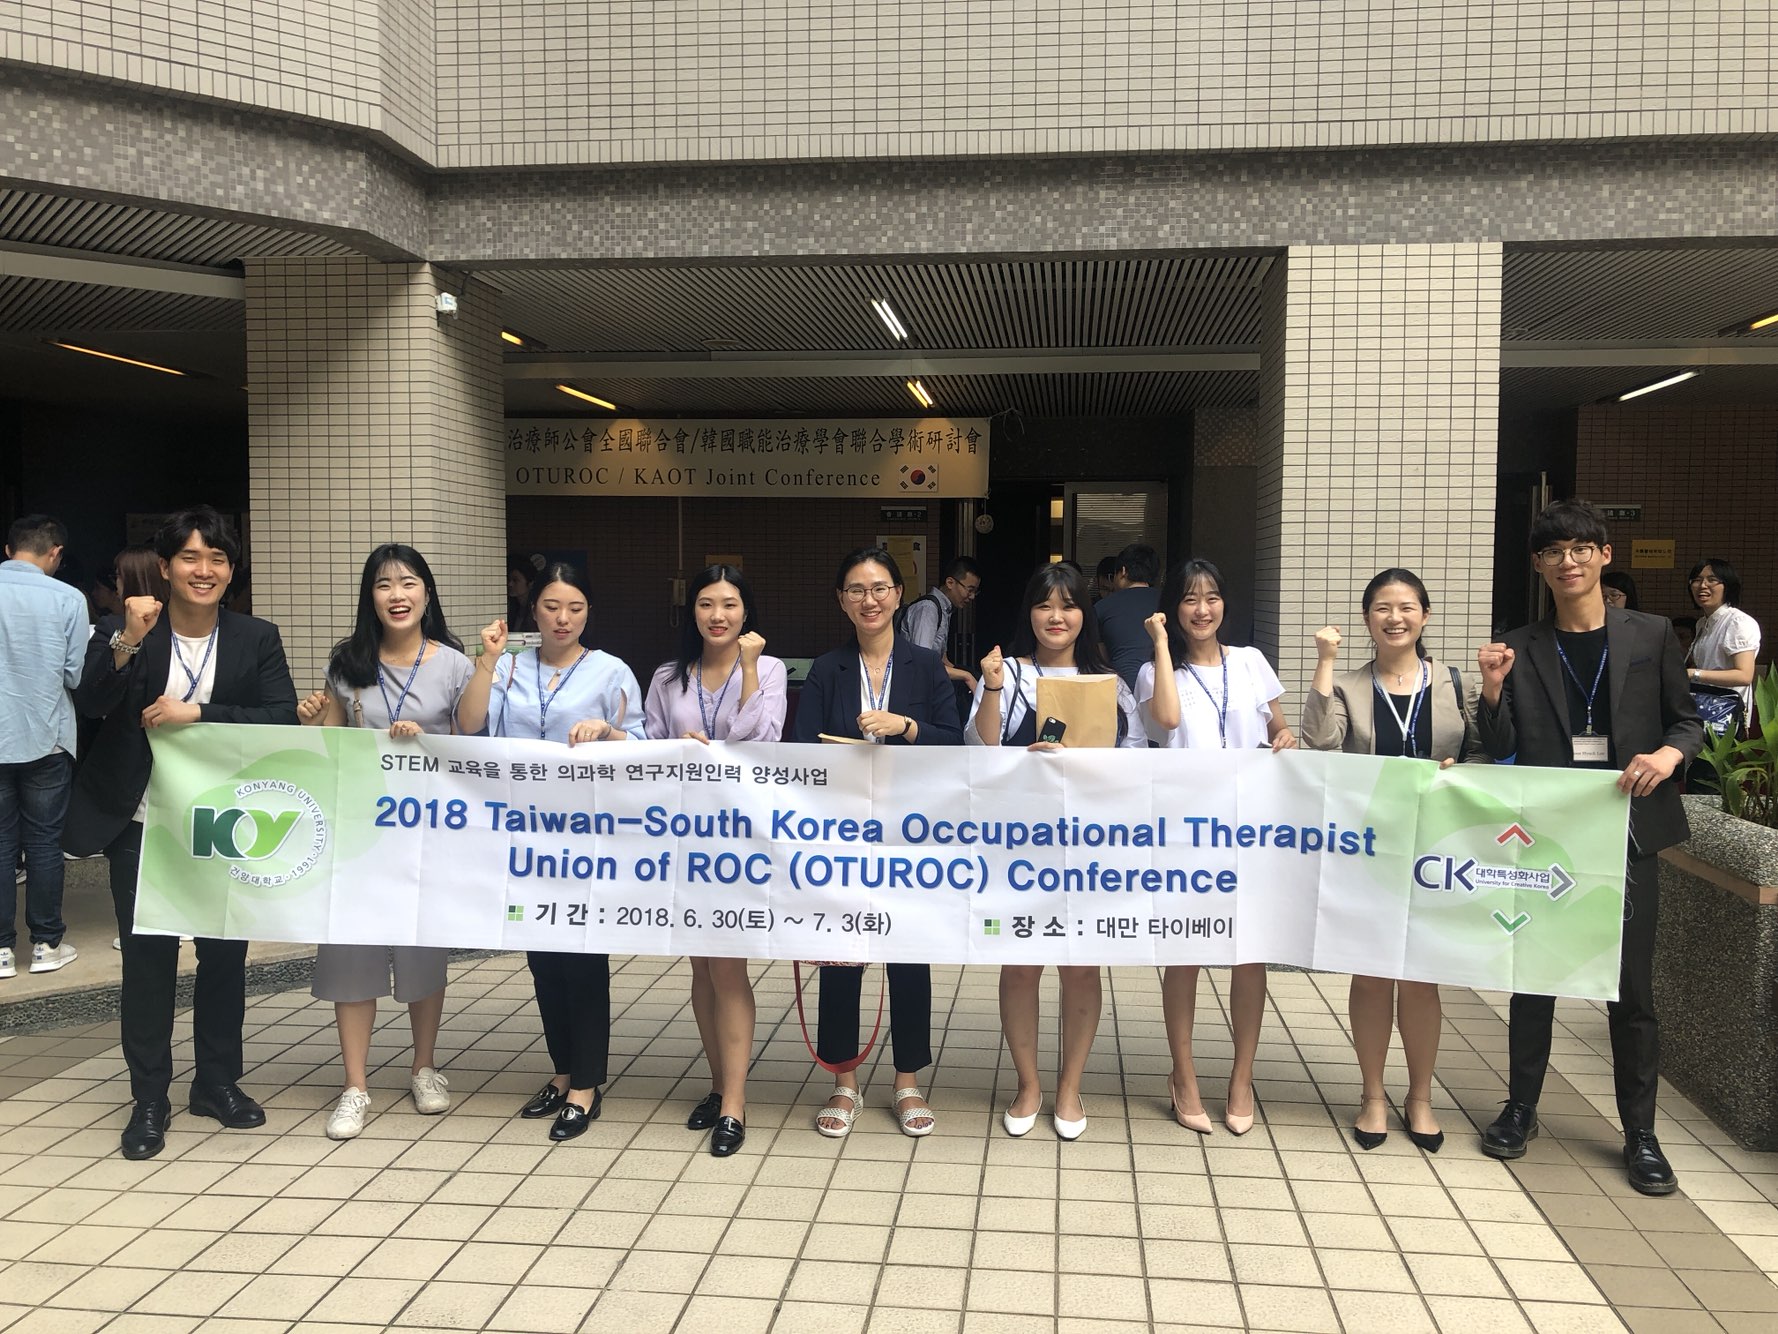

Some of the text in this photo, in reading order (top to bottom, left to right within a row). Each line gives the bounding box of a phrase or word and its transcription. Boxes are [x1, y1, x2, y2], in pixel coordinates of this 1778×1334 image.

[515, 466, 609, 485] OTUROC
[634, 466, 697, 485] KAOT
[705, 467, 756, 486] Joint
[764, 467, 881, 487] Conference
[380, 753, 828, 787] STEM 교육을 통한 의과학 연구지원인력 양성사업
[235, 780, 295, 797] KONYANG
[297, 790, 325, 852] UNIVERSITY
[374, 796, 469, 831] 2018
[771, 809, 884, 845] Korea
[901, 812, 1167, 851] Occupational
[1183, 816, 1378, 858] Therapist
[230, 866, 284, 886] 건양대학교
[291, 856, 316, 877] 1991
[508, 846, 1239, 894] Union of ROC (OTUROC) Conference
[1413, 855, 1476, 892] CK
[1475, 868, 1550, 884] 대학특성화사업
[616, 906, 675, 929] 2018.
[711, 907, 775, 933] 30(토)
[841, 910, 892, 936] 3(화)
[1096, 916, 1139, 939] 대만
[1148, 916, 1233, 939] 타이베이
